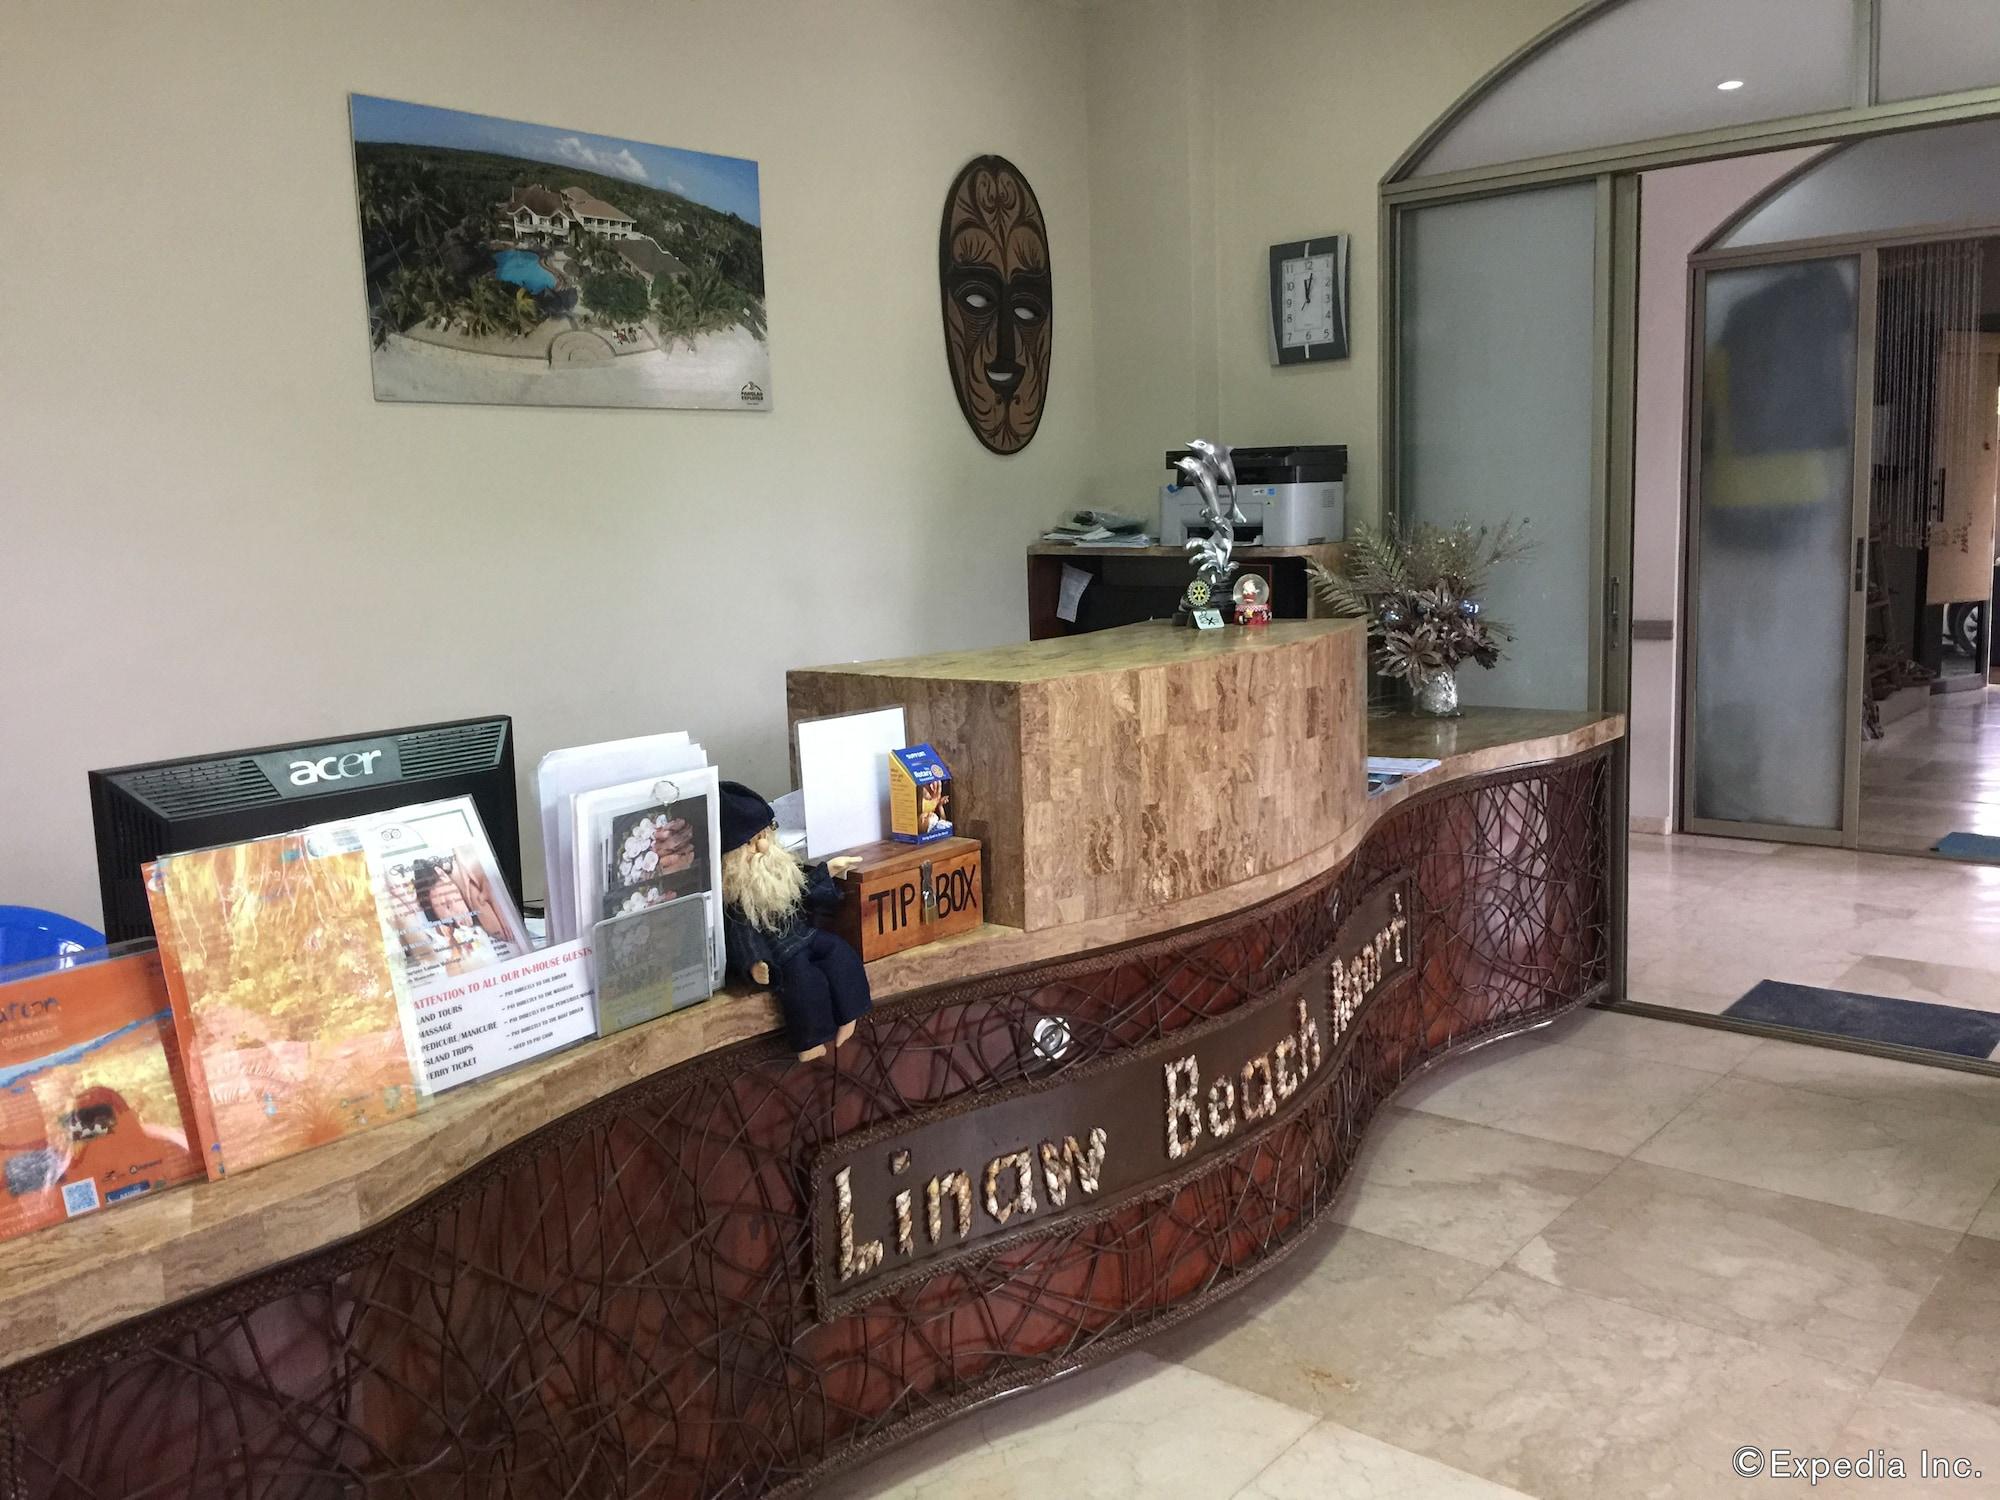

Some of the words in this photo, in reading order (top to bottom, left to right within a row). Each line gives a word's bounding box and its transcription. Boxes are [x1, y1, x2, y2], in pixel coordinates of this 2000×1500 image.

[1285, 264, 1294, 274] 11
[1304, 261, 1313, 271] 12
[1286, 282, 1295, 292] 10
[1325, 278, 1331, 287] 2
[1286, 298, 1292, 308] 9
[1325, 294, 1330, 304] 3
[1287, 314, 1293, 323] 8
[1325, 310, 1331, 319] 4
[1287, 332, 1292, 341] 7
[1305, 331, 1312, 341] 6
[1323, 328, 1330, 339] 5
[290, 750, 381, 786] acer
[869, 882, 915, 935] TIP
[936, 864, 977, 919] BOX
[413, 988, 466, 1010] ATTENTION
[468, 981, 480, 994] TO
[482, 977, 498, 989] ALL
[501, 970, 520, 983] OUR
[521, 957, 560, 977] IN-HOUSE
[563, 947, 593, 964] GUESTS
[438, 1004, 463, 1018] TOURS
[419, 1021, 453, 1039] MASSAGE
[421, 1021, 497, 1053] PEDICURE/MANICURE
[452, 1044, 474, 1057] TRIPS
[452, 1057, 477, 1072] TICKET
[832, 1126, 1108, 1282] Linaw
[1163, 996, 1322, 1161] Beach
[1331, 892, 1407, 1046] Resort
